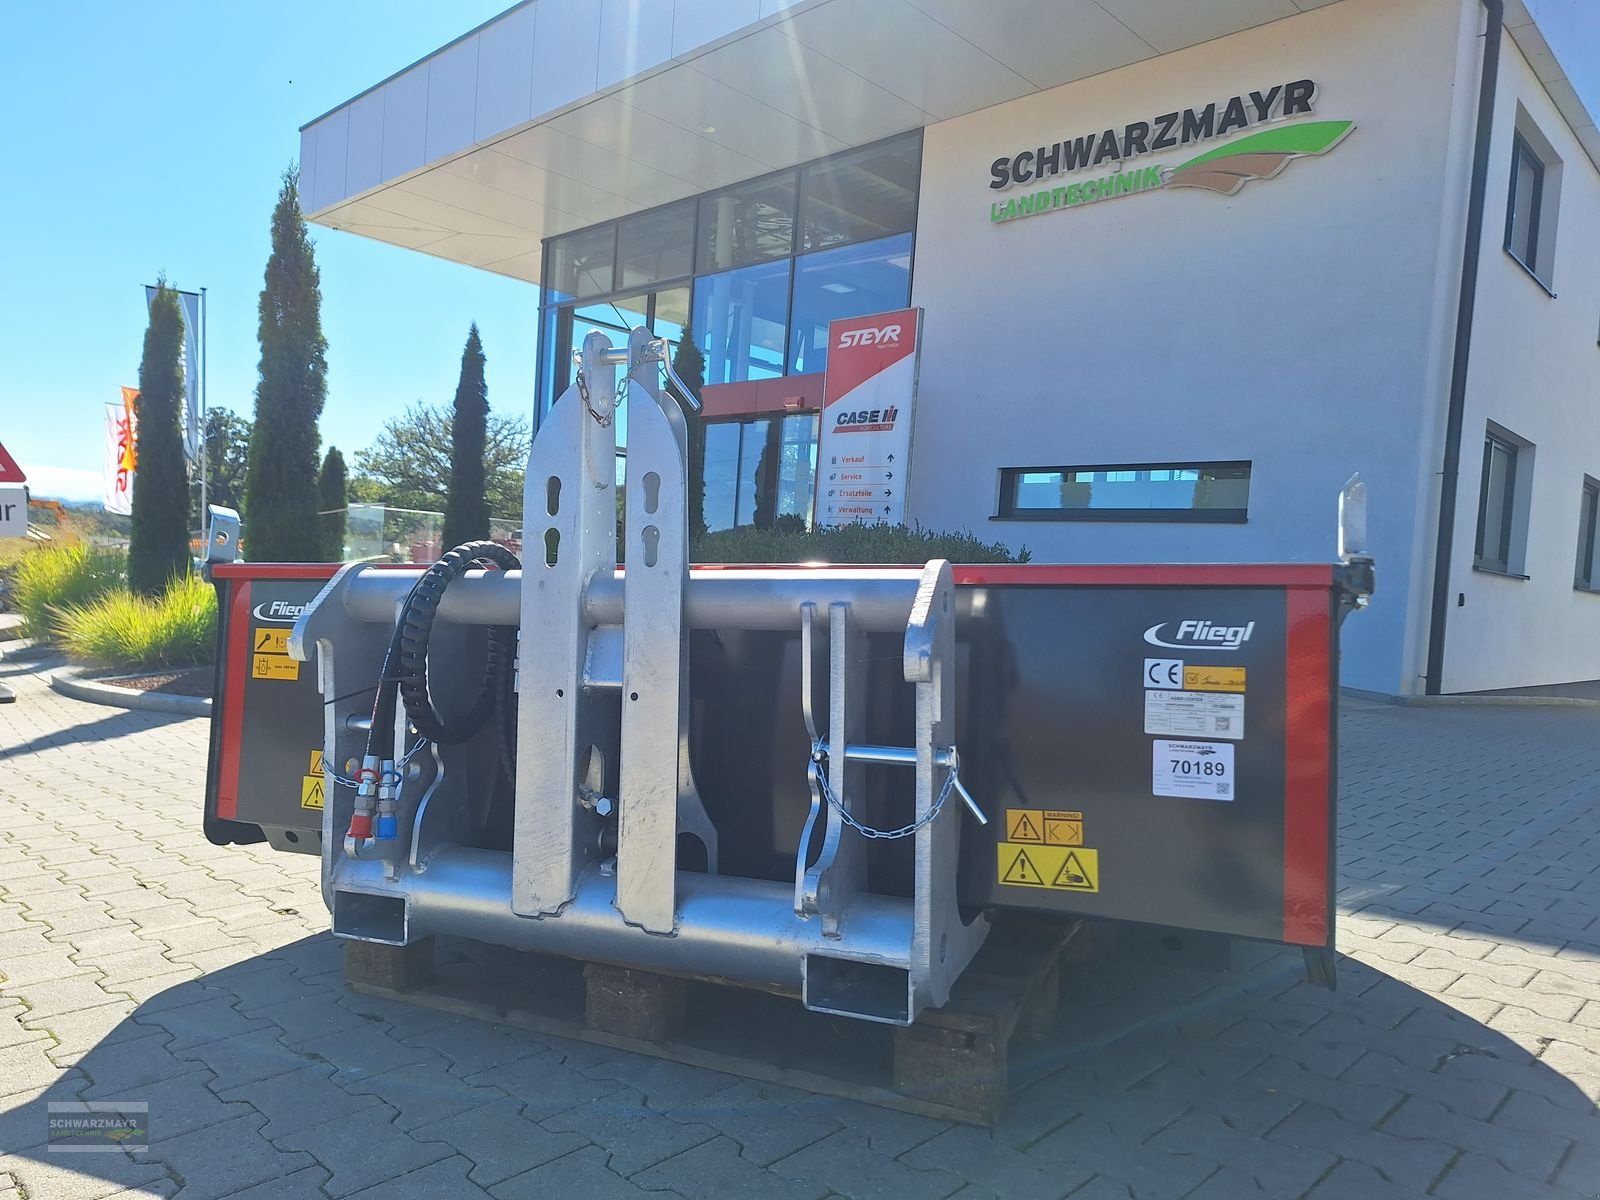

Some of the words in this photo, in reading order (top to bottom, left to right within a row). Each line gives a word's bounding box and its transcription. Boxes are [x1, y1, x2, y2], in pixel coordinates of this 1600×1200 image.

[989, 78, 1316, 190] SCHWARZMAYR
[990, 163, 1163, 223] LANDTECHNIK
[838, 325, 902, 348] STEYR
[836, 410, 880, 425] CASE
[840, 472, 863, 481] Service
[839, 488, 873, 498] Ersatzteile
[838, 505, 873, 515] Verwaltung
[1176, 620, 1255, 646] Fliegl
[1149, 663, 1179, 684] CE
[1170, 760, 1225, 776] 70189
